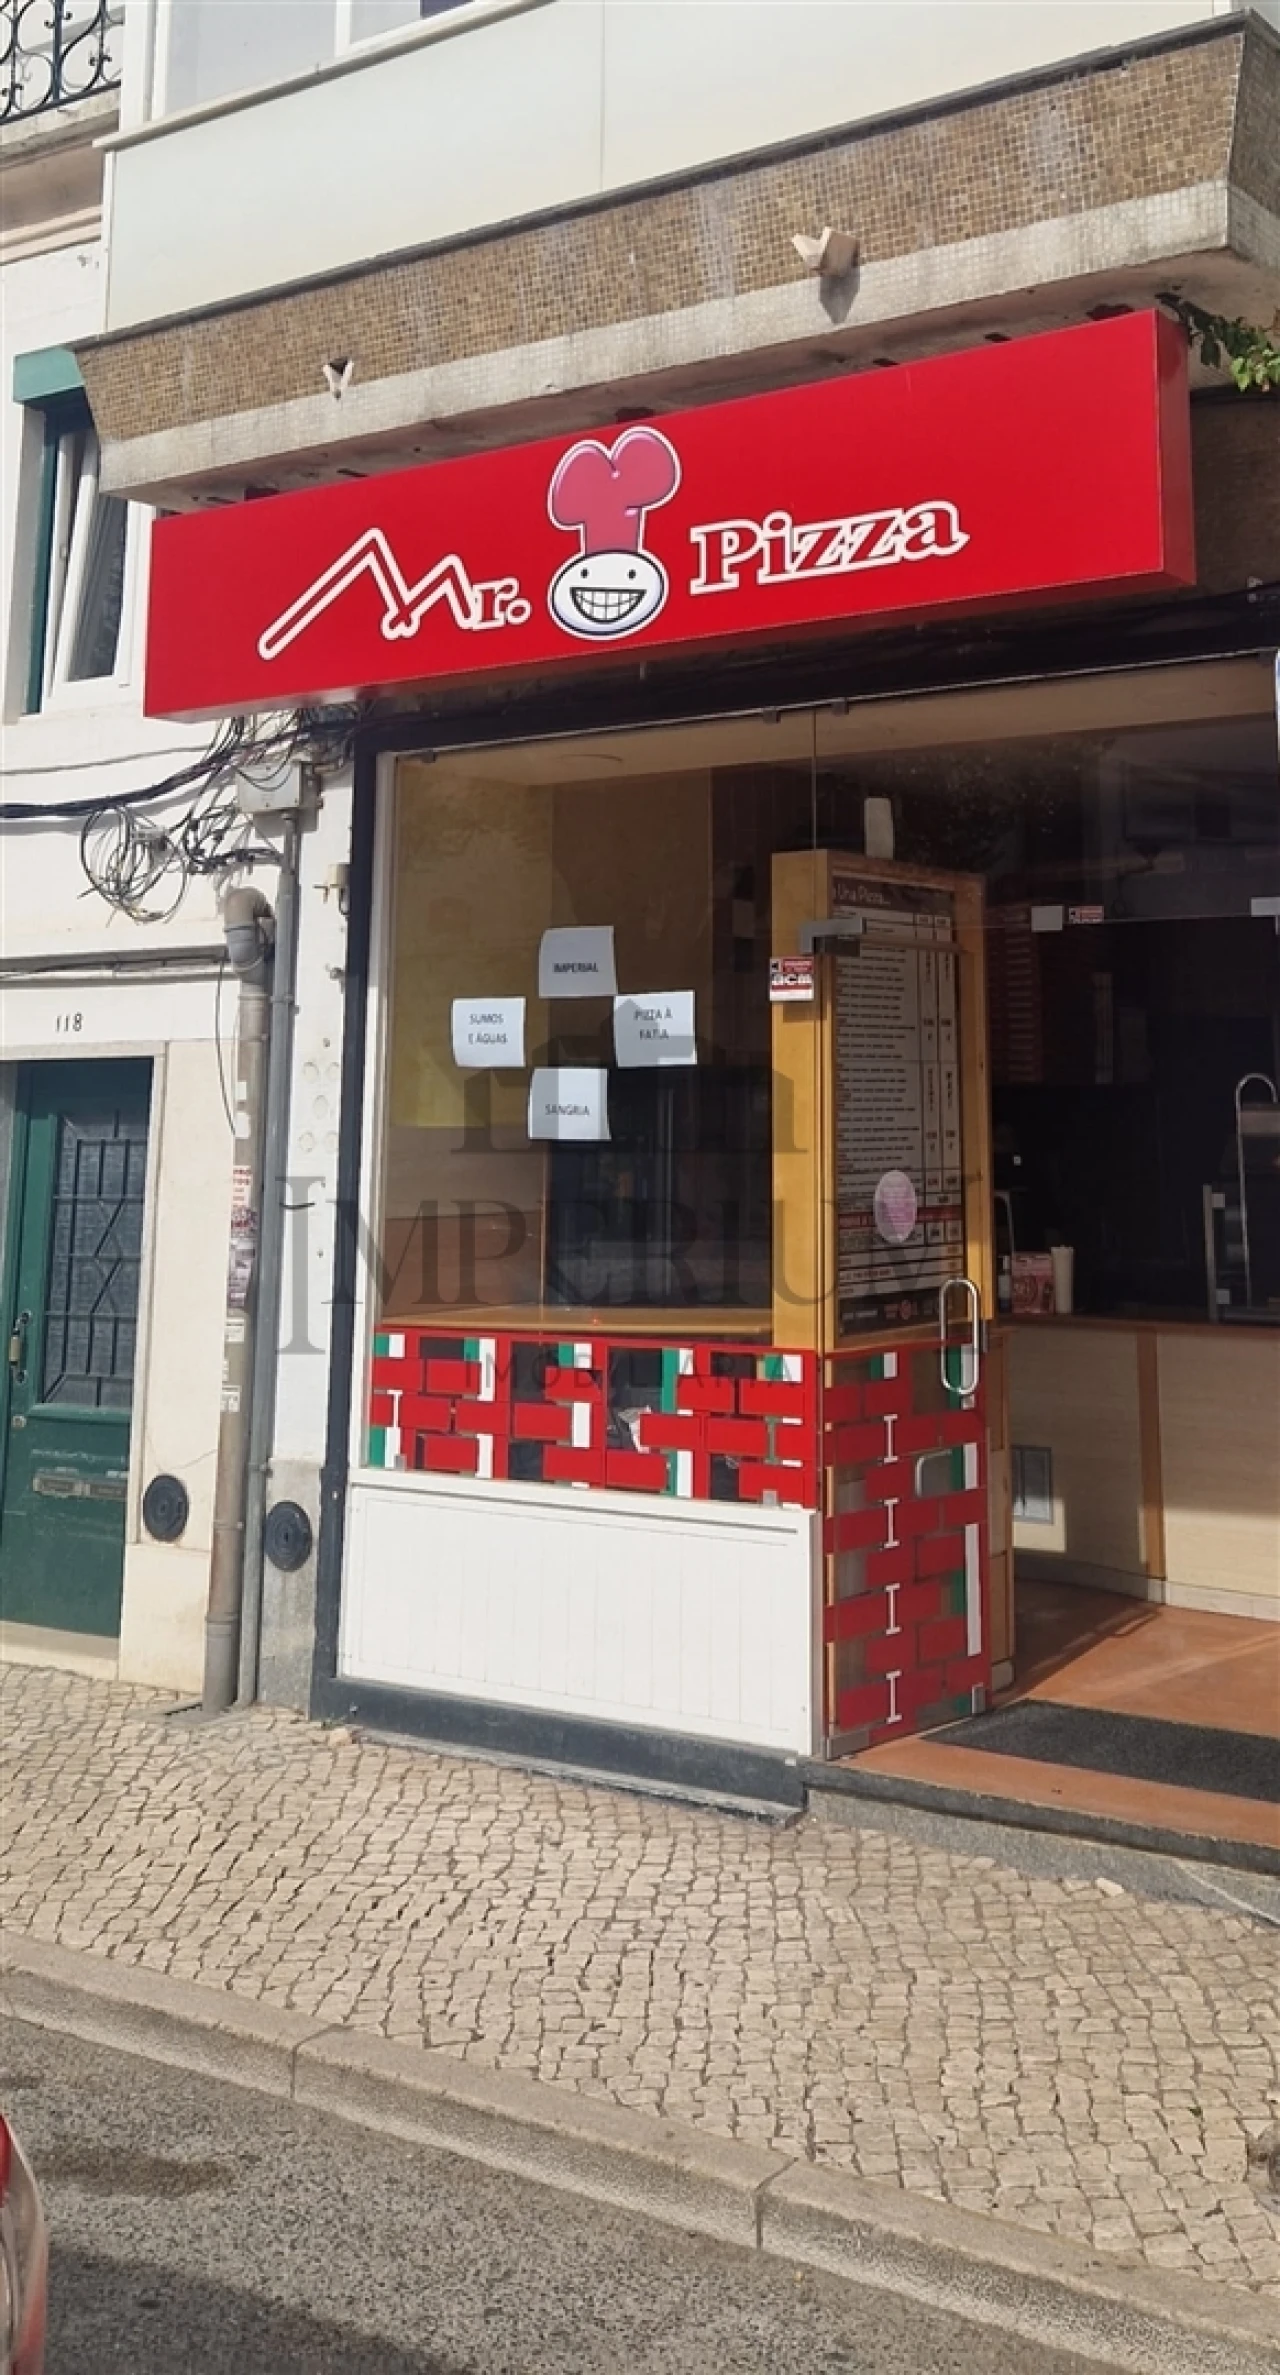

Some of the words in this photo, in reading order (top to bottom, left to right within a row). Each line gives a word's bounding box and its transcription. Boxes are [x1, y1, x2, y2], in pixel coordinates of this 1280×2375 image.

[257, 528, 531, 661] Mr.
[689, 499, 970, 595] Pizza
[552, 961, 599, 974] IMPERIAL
[55, 1011, 83, 1033] 118
[468, 1012, 505, 1026] SUMOS
[544, 1103, 591, 1116] SANGRIA
